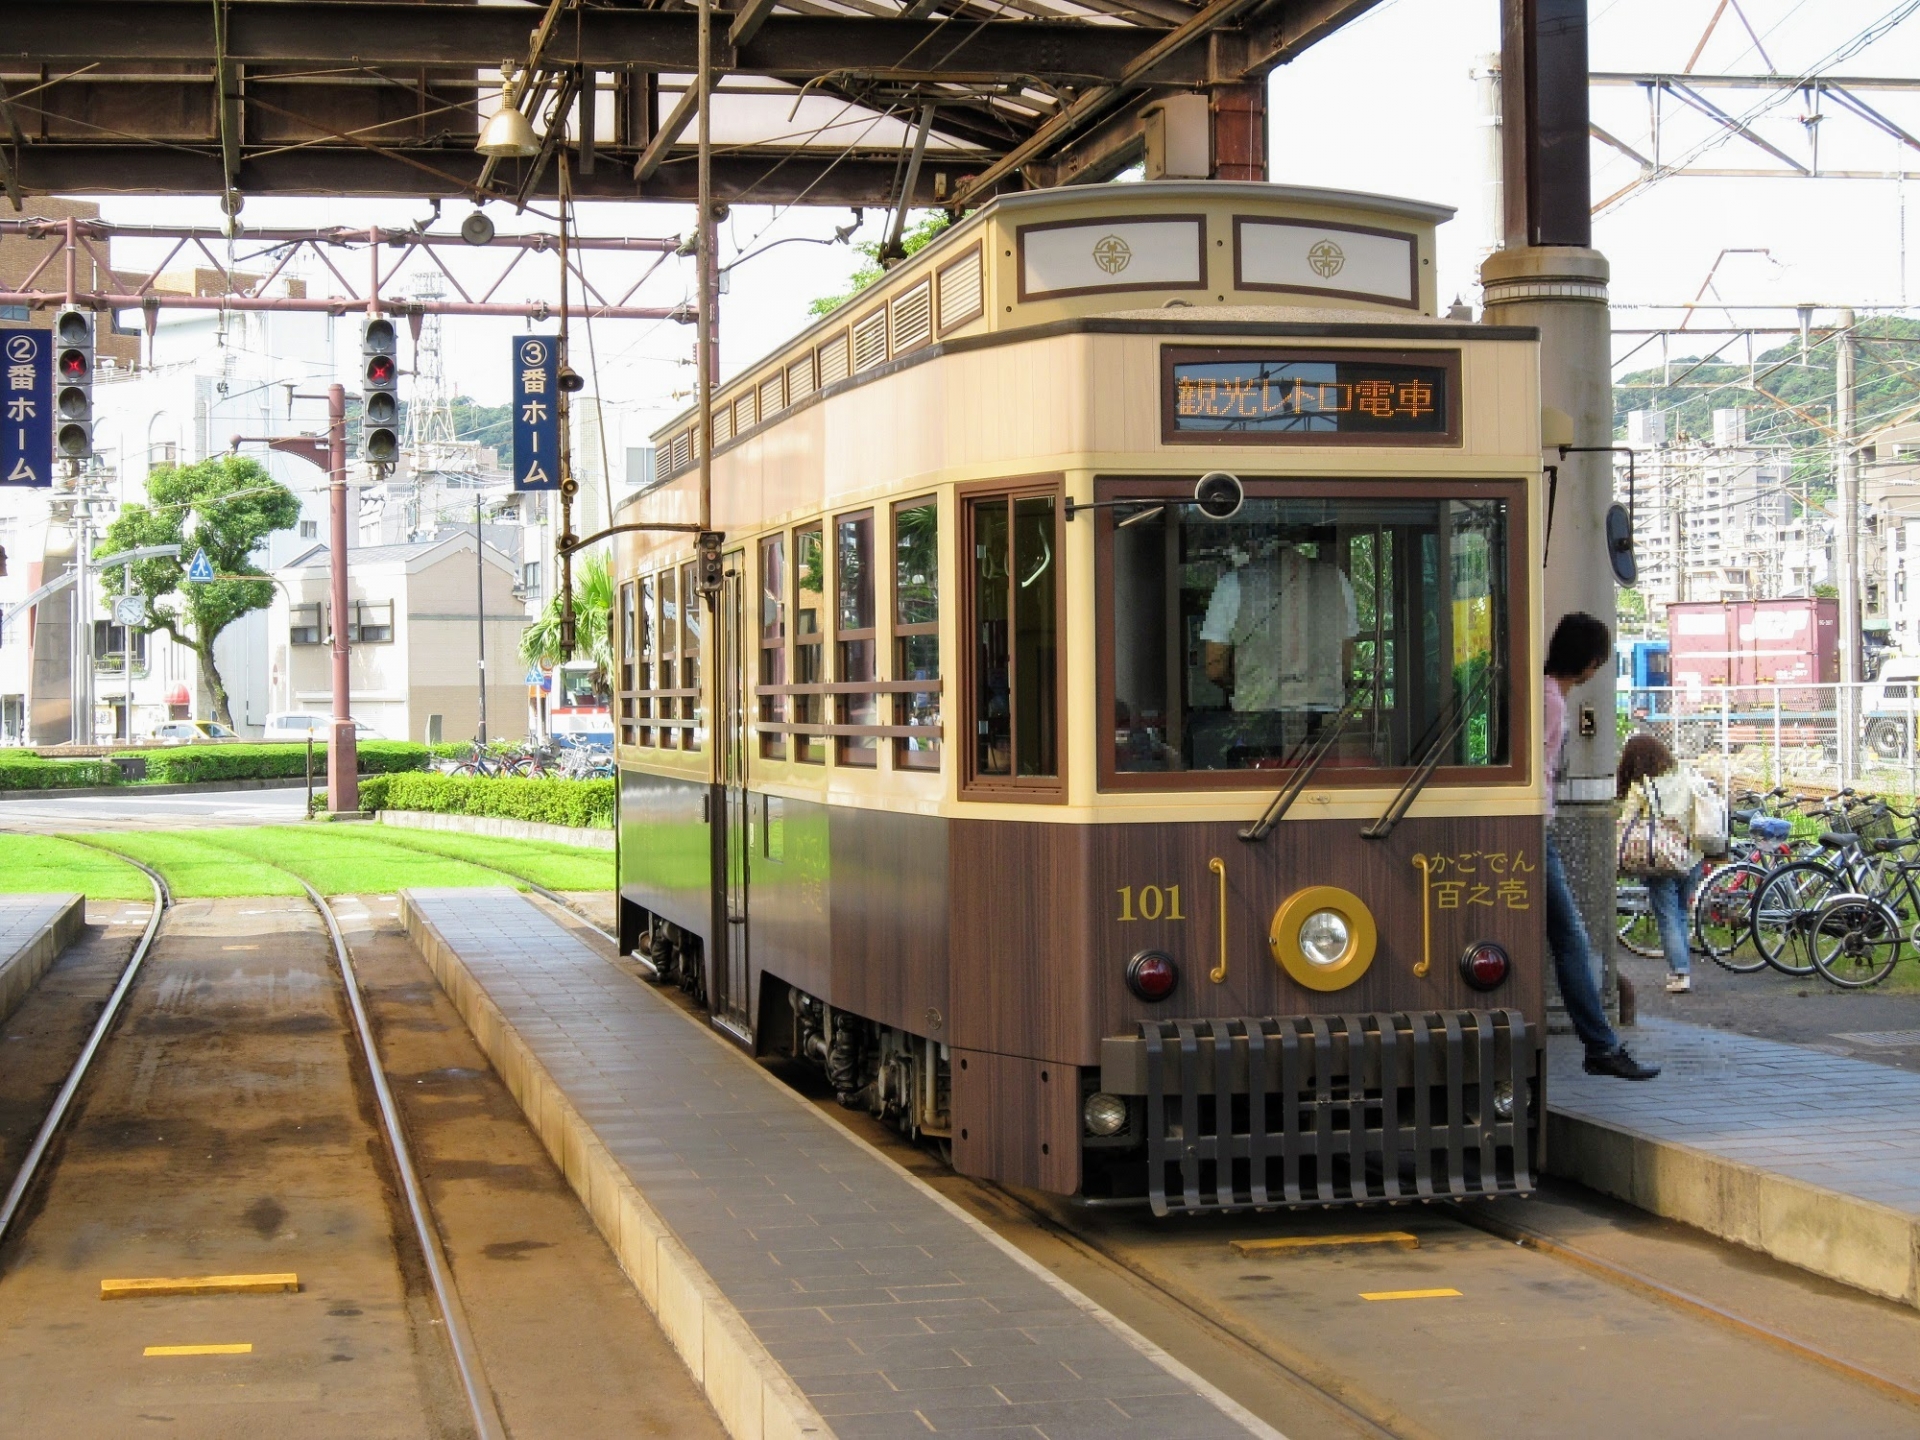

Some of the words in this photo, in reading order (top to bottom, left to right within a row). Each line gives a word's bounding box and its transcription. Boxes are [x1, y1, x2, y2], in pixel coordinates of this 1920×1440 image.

[1176, 375, 1435, 418] 観光レトロ電車
[1428, 850, 1536, 874] かごでん
[1116, 884, 1186, 921] 101
[1430, 877, 1531, 910] 百之壱
